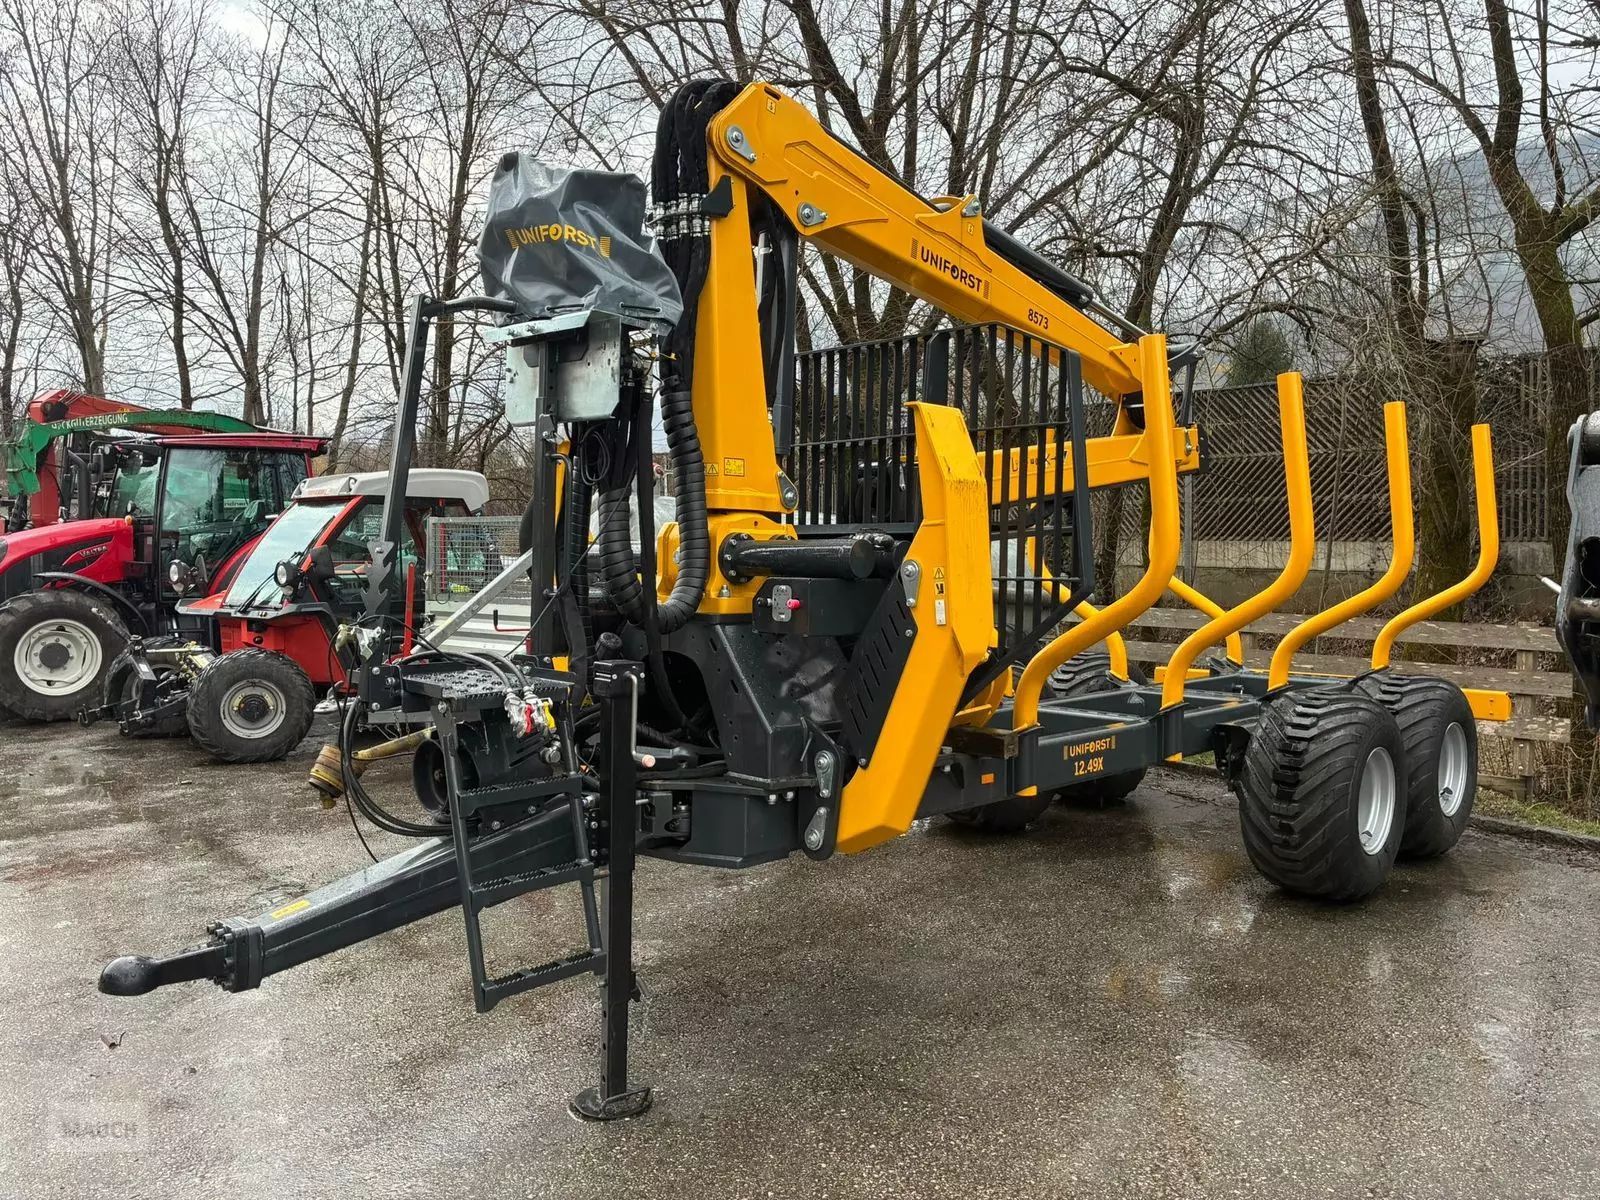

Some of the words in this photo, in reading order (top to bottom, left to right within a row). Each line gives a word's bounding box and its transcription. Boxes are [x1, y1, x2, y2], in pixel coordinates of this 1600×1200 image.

[516, 223, 597, 249] UNIFORST
[920, 246, 982, 292] UNIFORST
[1027, 308, 1049, 330] 8573
[1069, 737, 1111, 757] UNIFORST
[1074, 756, 1104, 776] 12.49X
